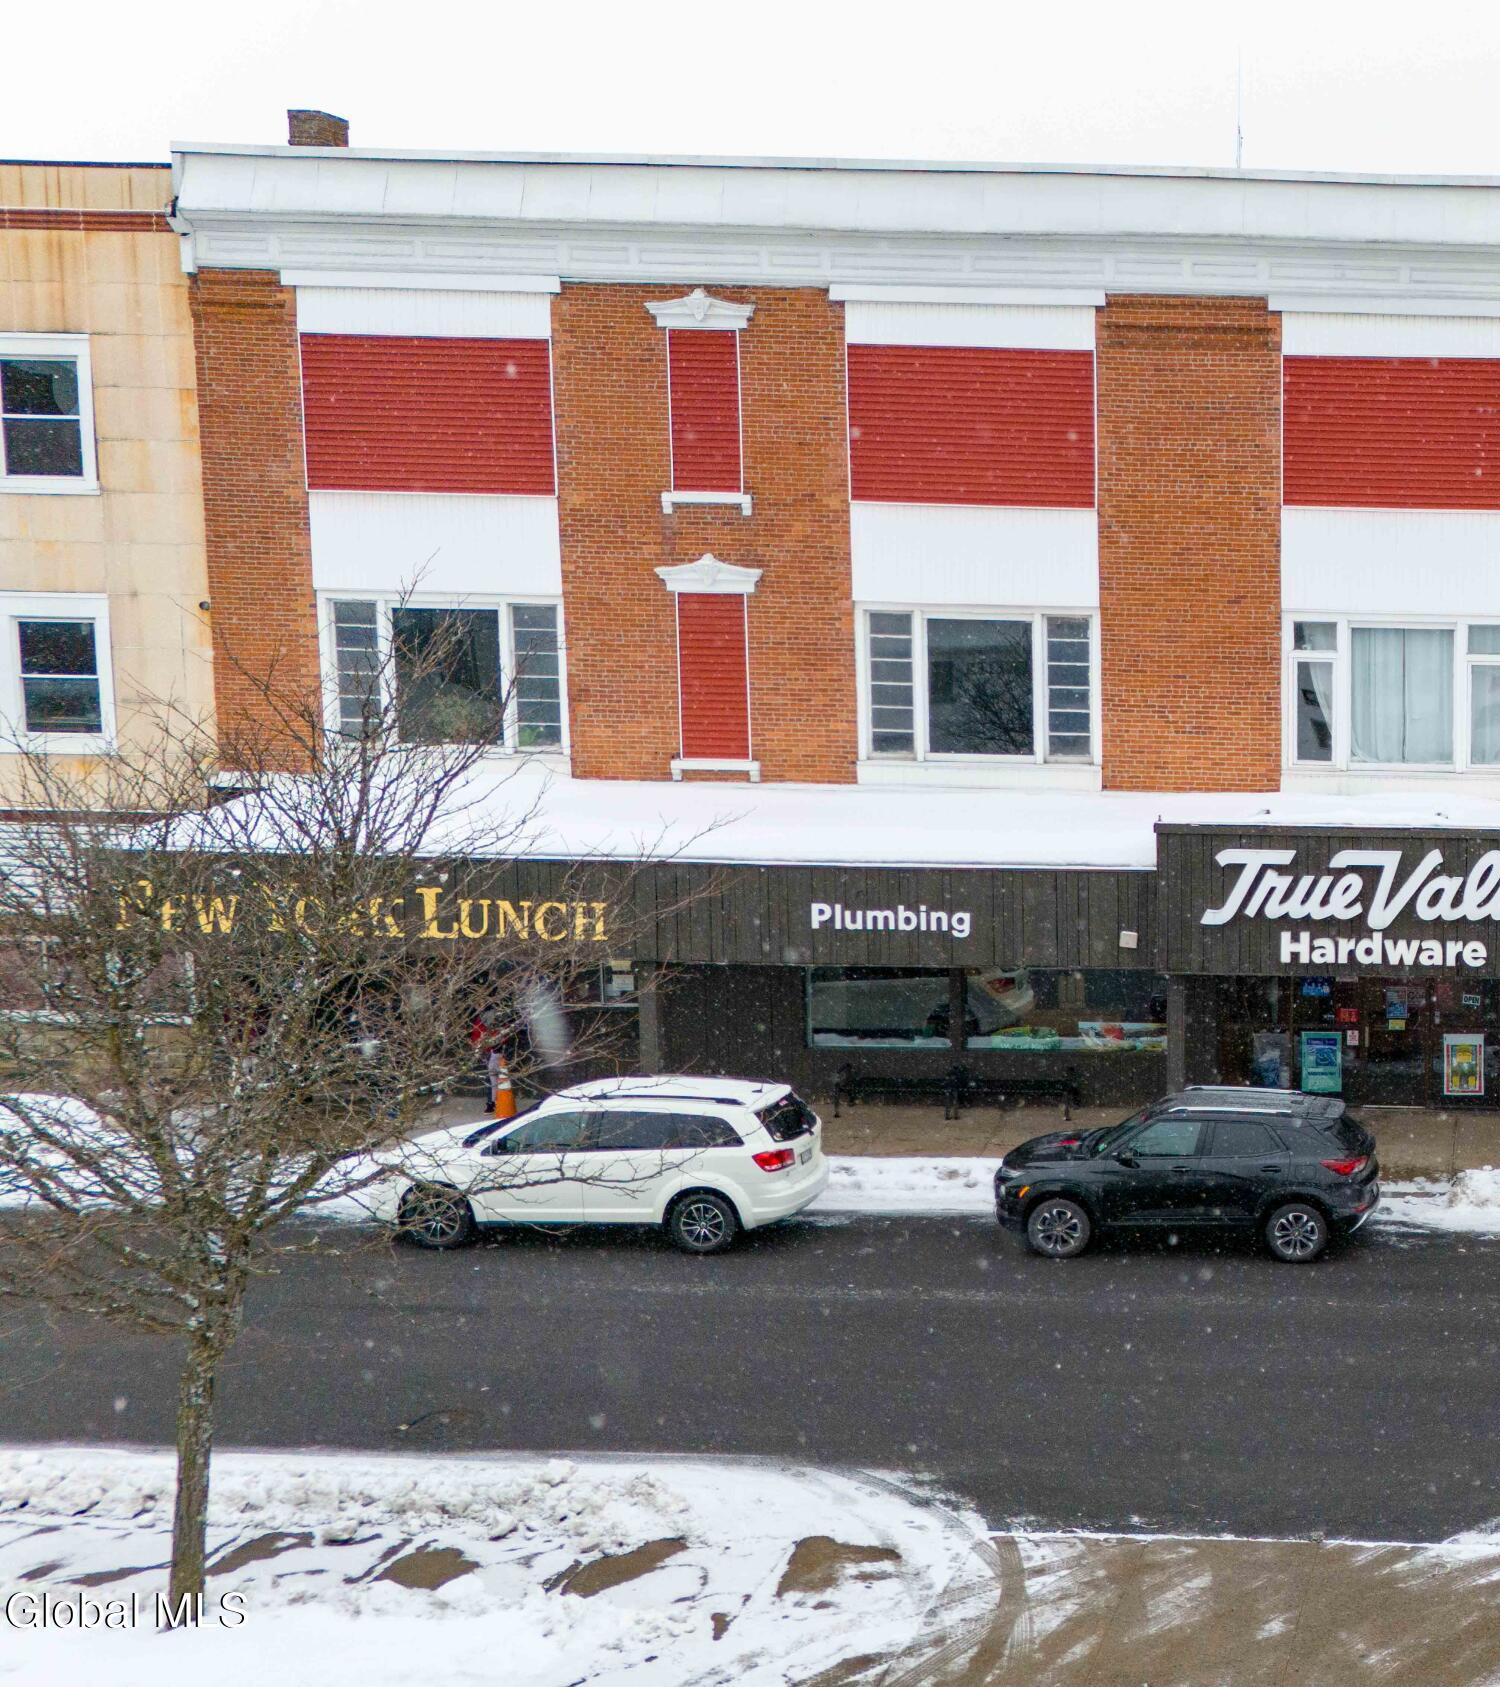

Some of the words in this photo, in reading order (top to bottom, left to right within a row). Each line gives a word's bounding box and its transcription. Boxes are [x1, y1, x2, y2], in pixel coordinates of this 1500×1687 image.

[1200, 849, 1363, 925] True
[415, 886, 609, 941] LUNCH
[811, 903, 971, 938] Plumbing
[1280, 931, 1487, 967] Hardware
[1463, 995, 1480, 1004] OPEN
